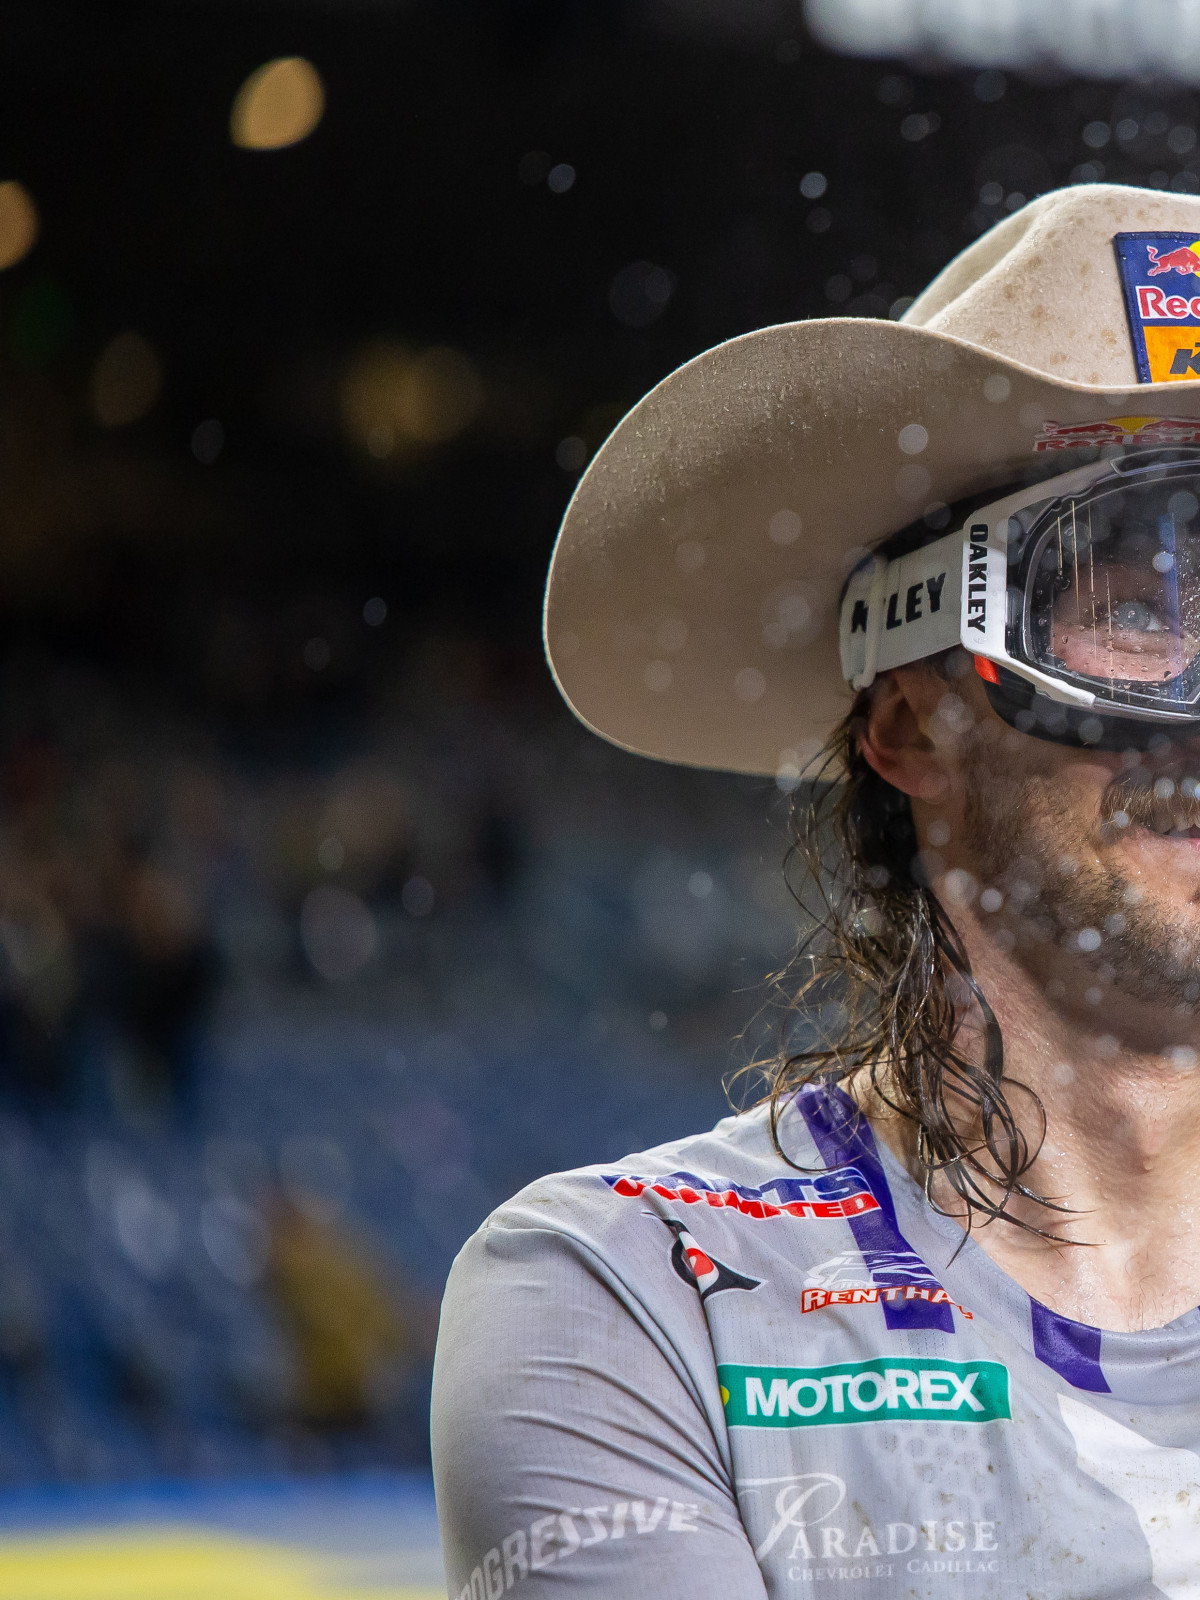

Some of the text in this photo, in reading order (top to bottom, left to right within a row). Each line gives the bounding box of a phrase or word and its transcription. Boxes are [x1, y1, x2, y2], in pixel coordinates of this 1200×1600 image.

[1034, 434, 1125, 451] Red
[967, 523, 989, 634] OAKLEY
[745, 1369, 986, 1418] MOTOREX
[454, 1496, 700, 1600] OGRESSIVE
[735, 1472, 999, 1561] PARADISE
[788, 1558, 1000, 1582] CHEVROLET CADILLAC
